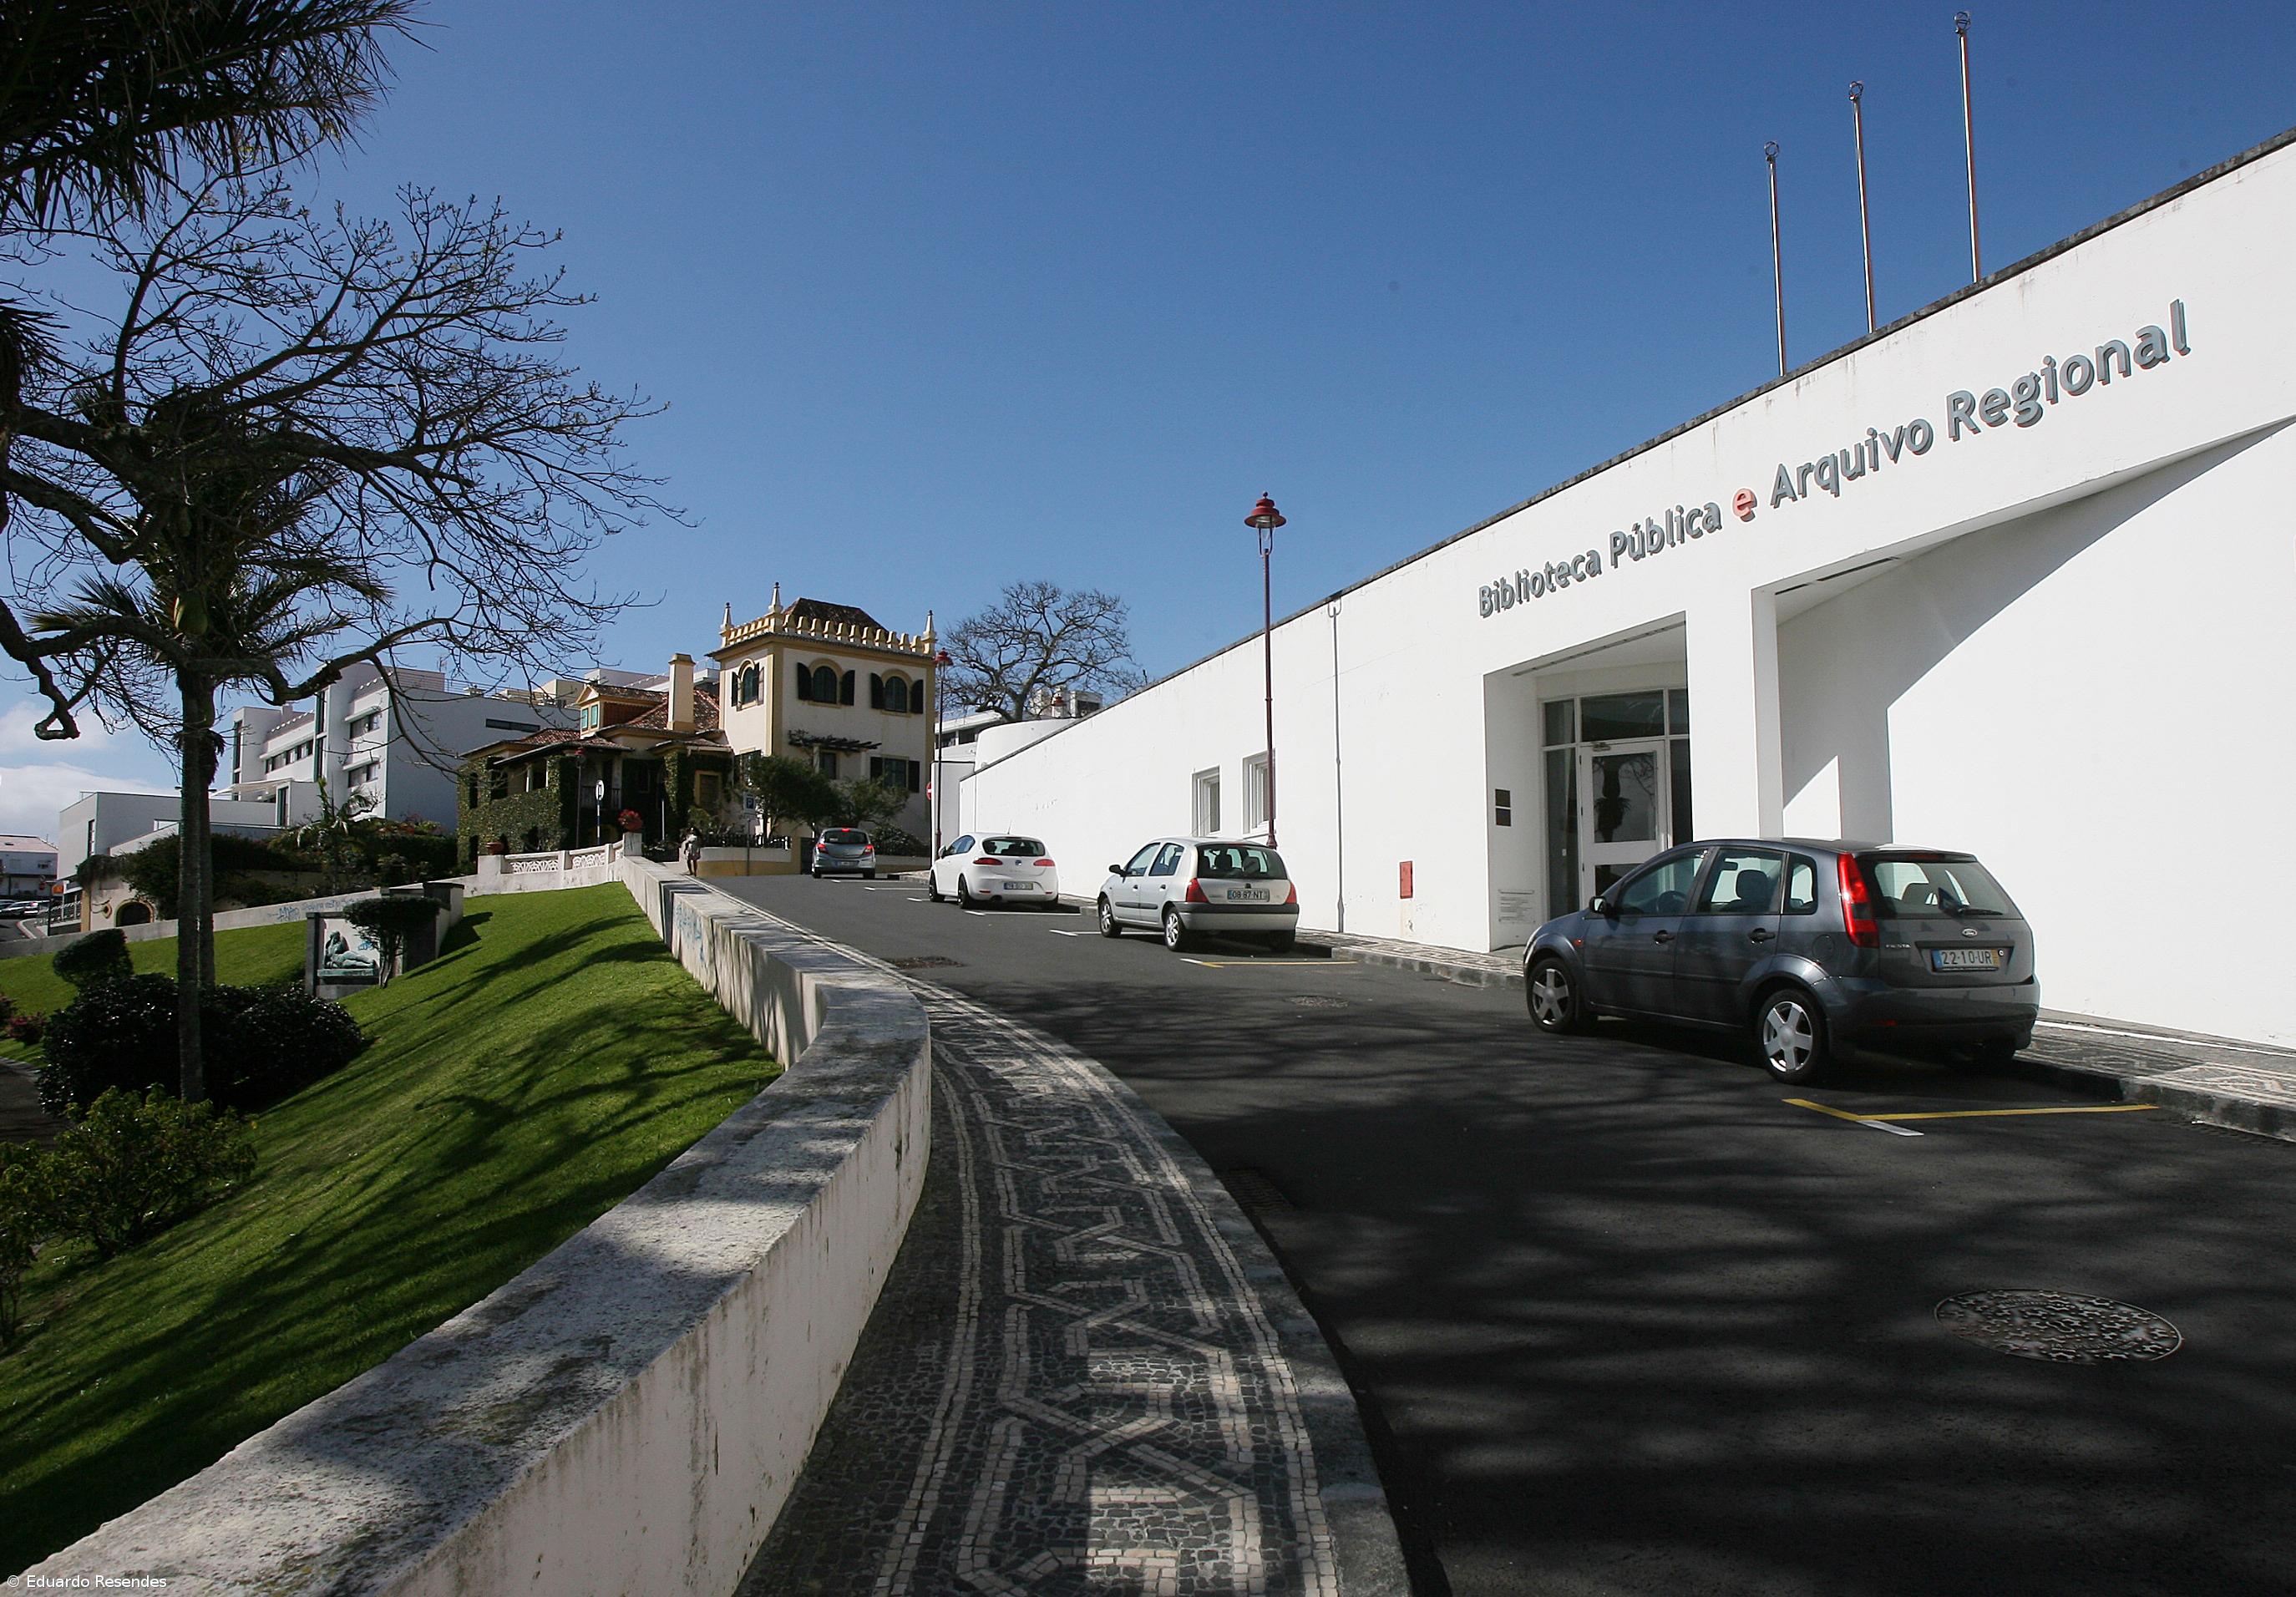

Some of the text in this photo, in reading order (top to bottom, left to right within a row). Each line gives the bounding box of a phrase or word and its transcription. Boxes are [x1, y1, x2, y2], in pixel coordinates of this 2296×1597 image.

[1478, 298, 2191, 619] Biblioteca Pública e Arquivo Regional
